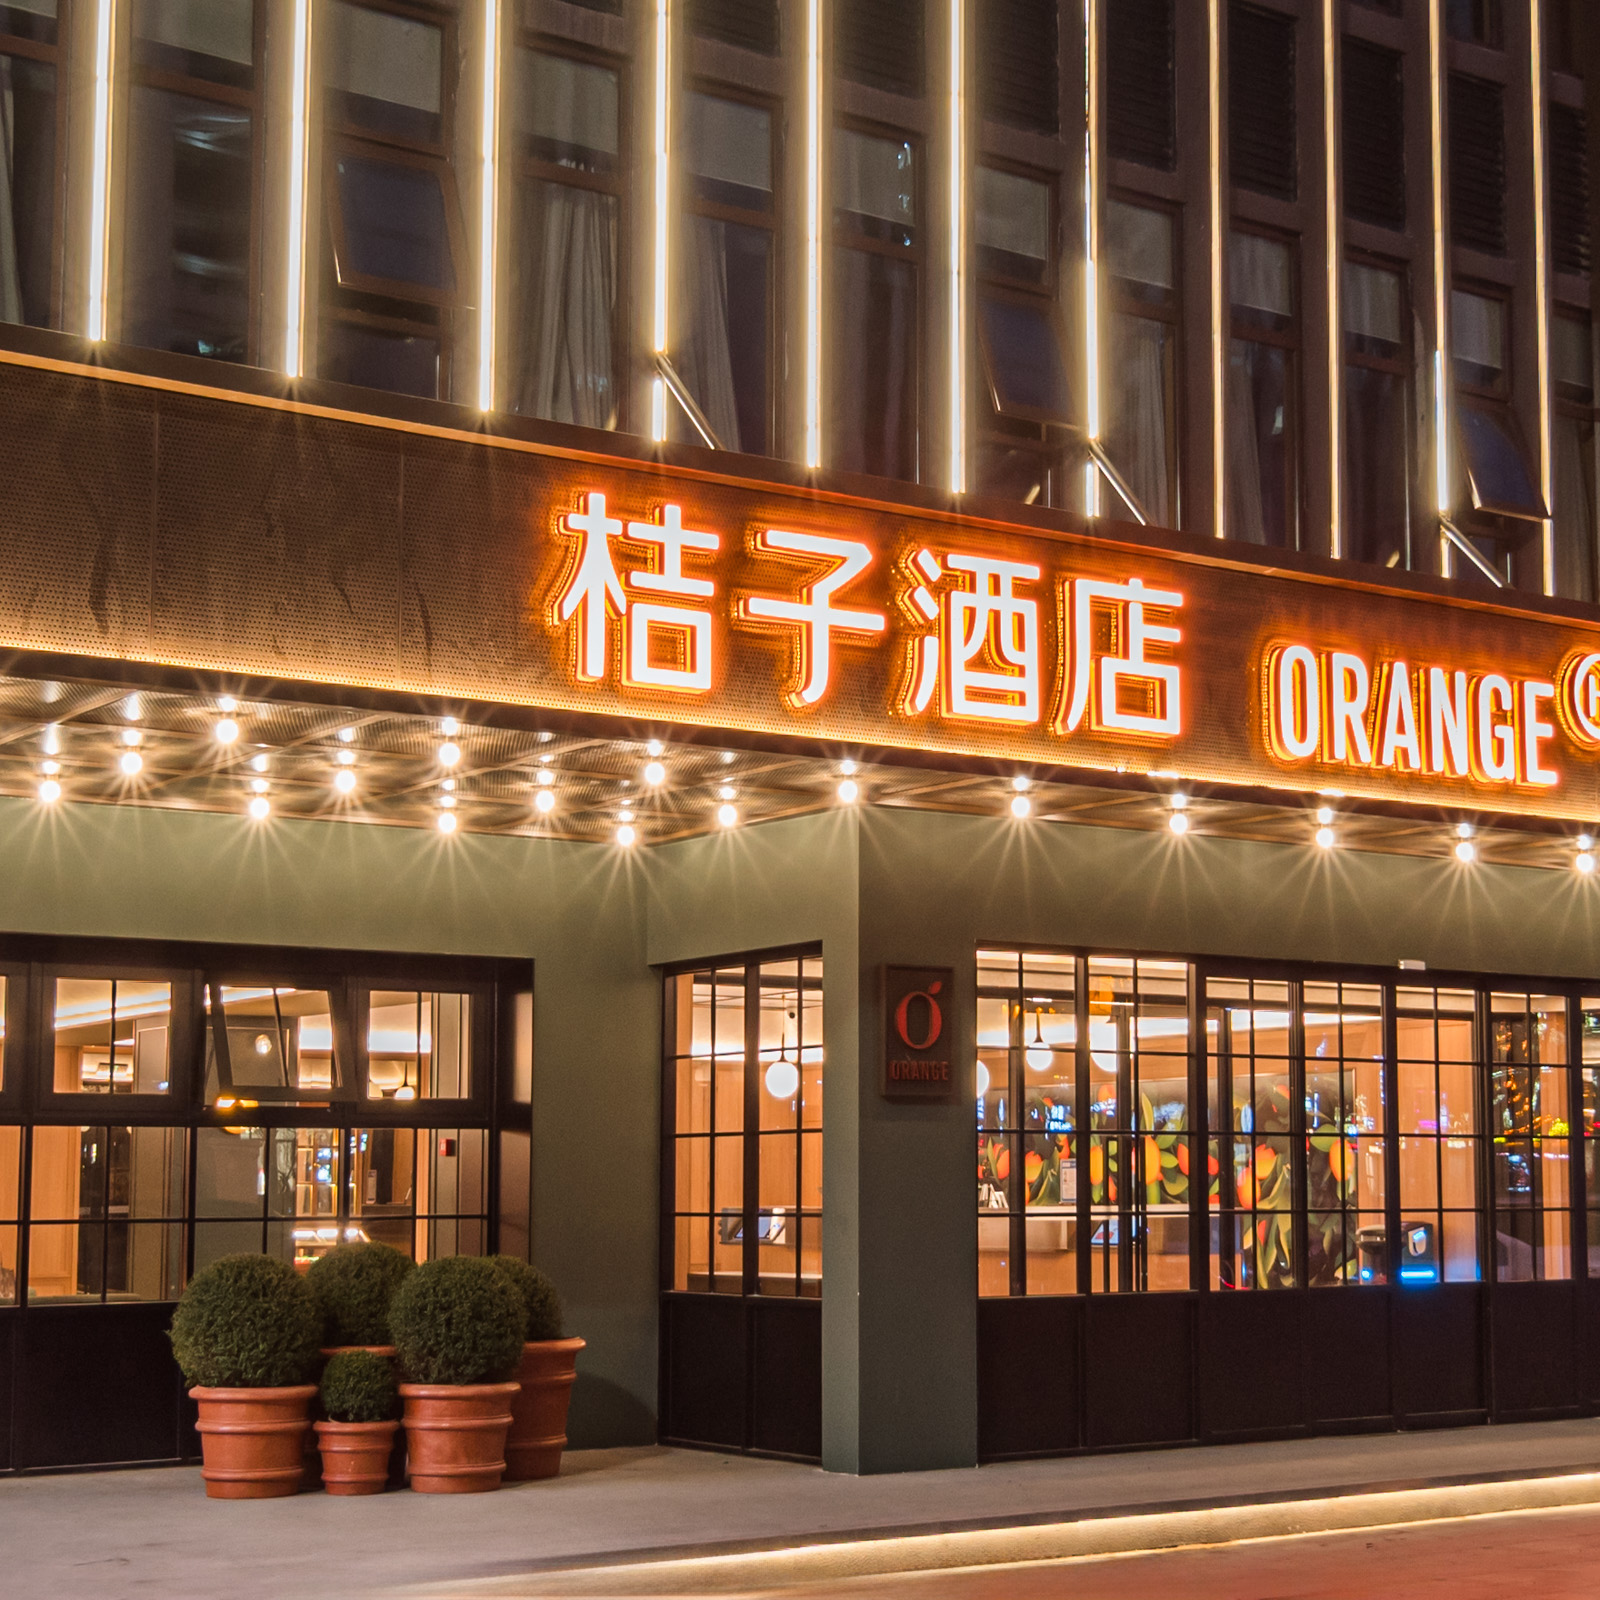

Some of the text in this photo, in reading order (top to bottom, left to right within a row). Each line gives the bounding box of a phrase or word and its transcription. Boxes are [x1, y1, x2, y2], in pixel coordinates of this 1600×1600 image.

[560, 490, 1185, 738] 桔子酒店
[1278, 643, 1559, 785] ORANGE
[888, 1061, 949, 1080] ORANGE
